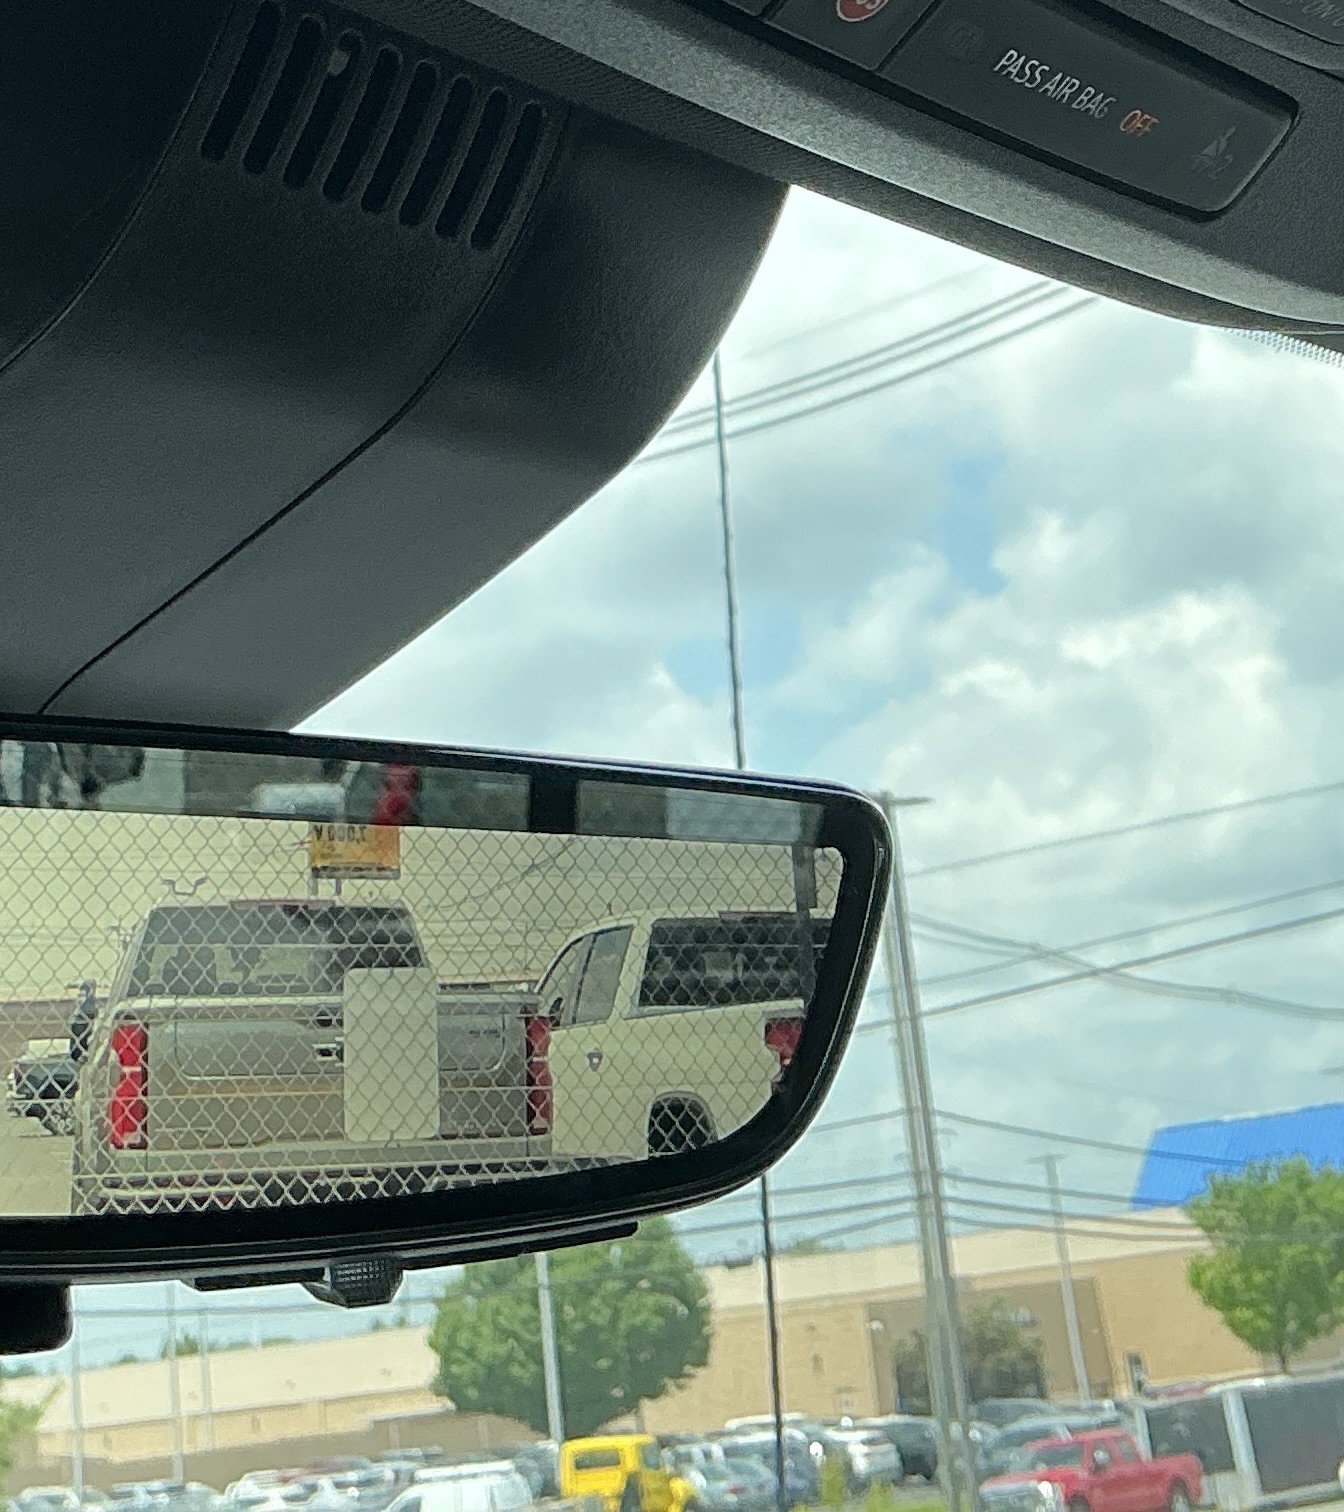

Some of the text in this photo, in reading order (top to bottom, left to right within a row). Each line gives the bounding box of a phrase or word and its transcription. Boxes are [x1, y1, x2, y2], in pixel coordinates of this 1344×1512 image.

[992, 48, 1161, 138] PASS AIR BAG OFF
